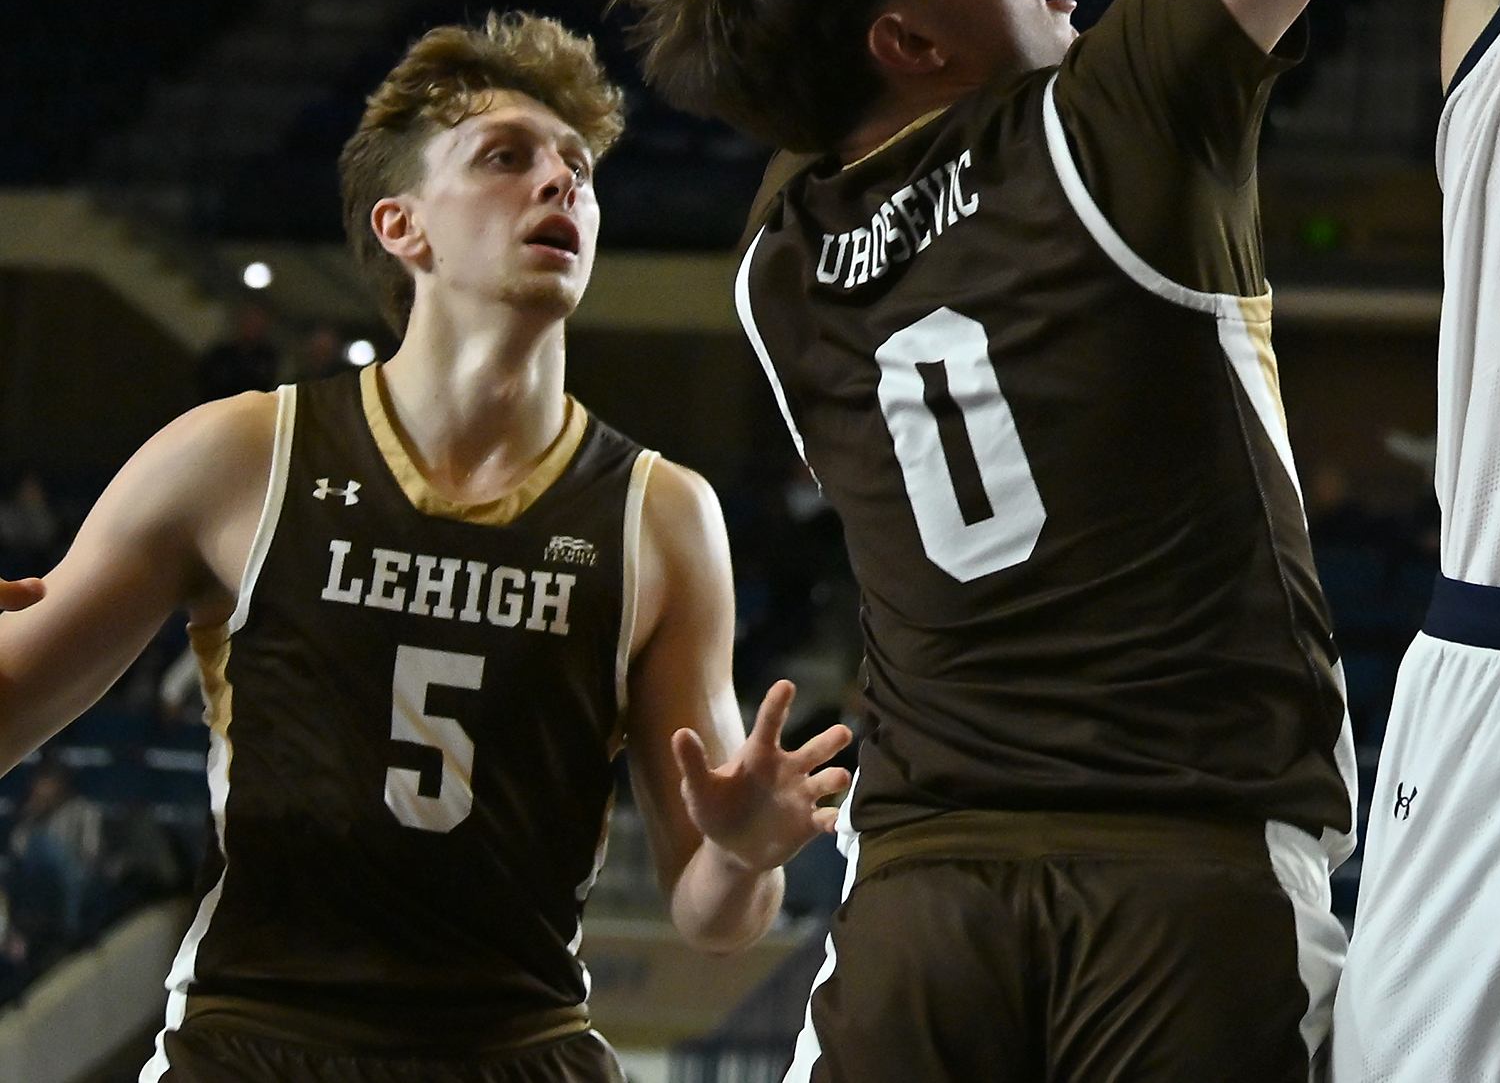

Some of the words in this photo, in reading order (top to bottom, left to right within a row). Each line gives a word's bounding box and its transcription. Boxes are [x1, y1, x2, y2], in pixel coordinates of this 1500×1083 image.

[816, 148, 980, 289] UROSEVIC
[875, 306, 1047, 583] 0
[321, 539, 576, 635] LEHIGH
[384, 645, 485, 833] 5
